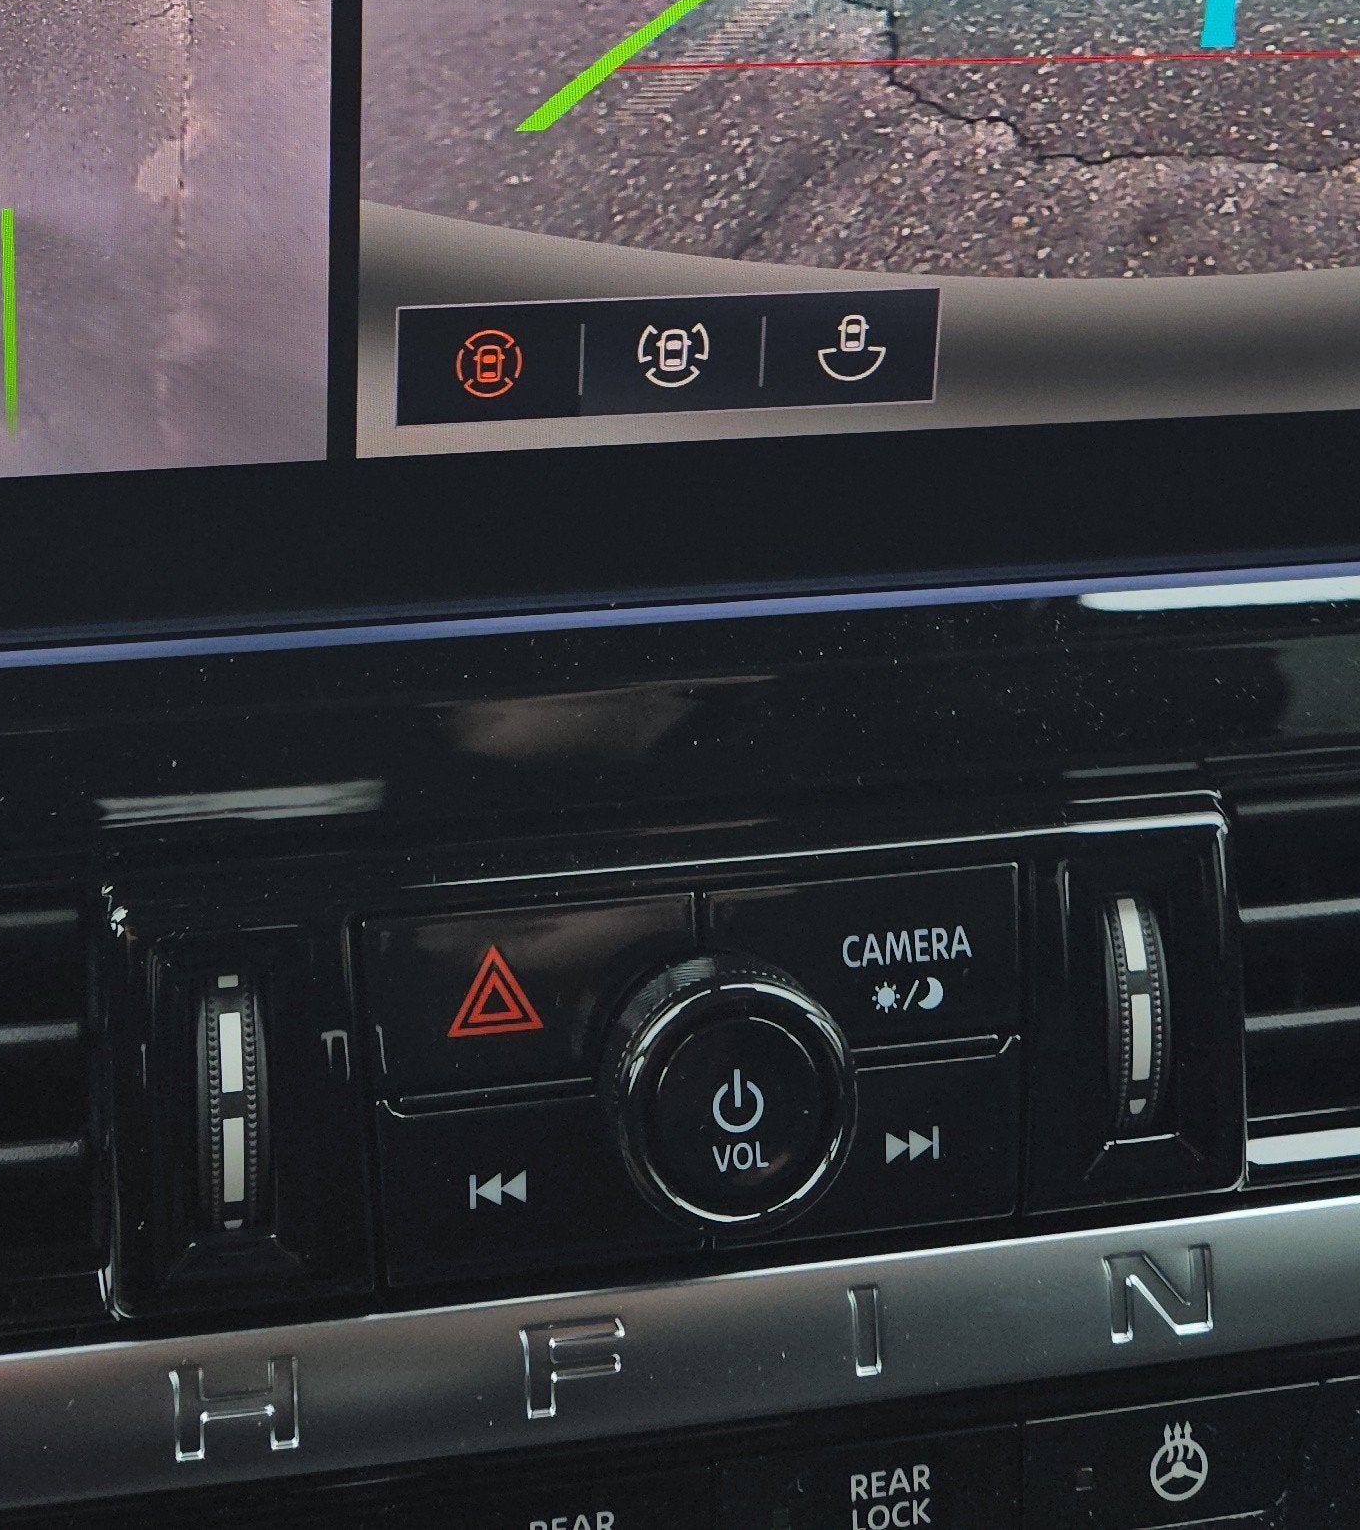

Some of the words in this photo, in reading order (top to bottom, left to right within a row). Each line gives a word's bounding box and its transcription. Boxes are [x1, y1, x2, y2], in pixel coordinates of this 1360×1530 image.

[842, 925, 973, 968] CAMERA
[712, 1140, 770, 1173] VOL
[850, 1463, 931, 1503] REAR
[852, 1497, 932, 1530] LOCK
